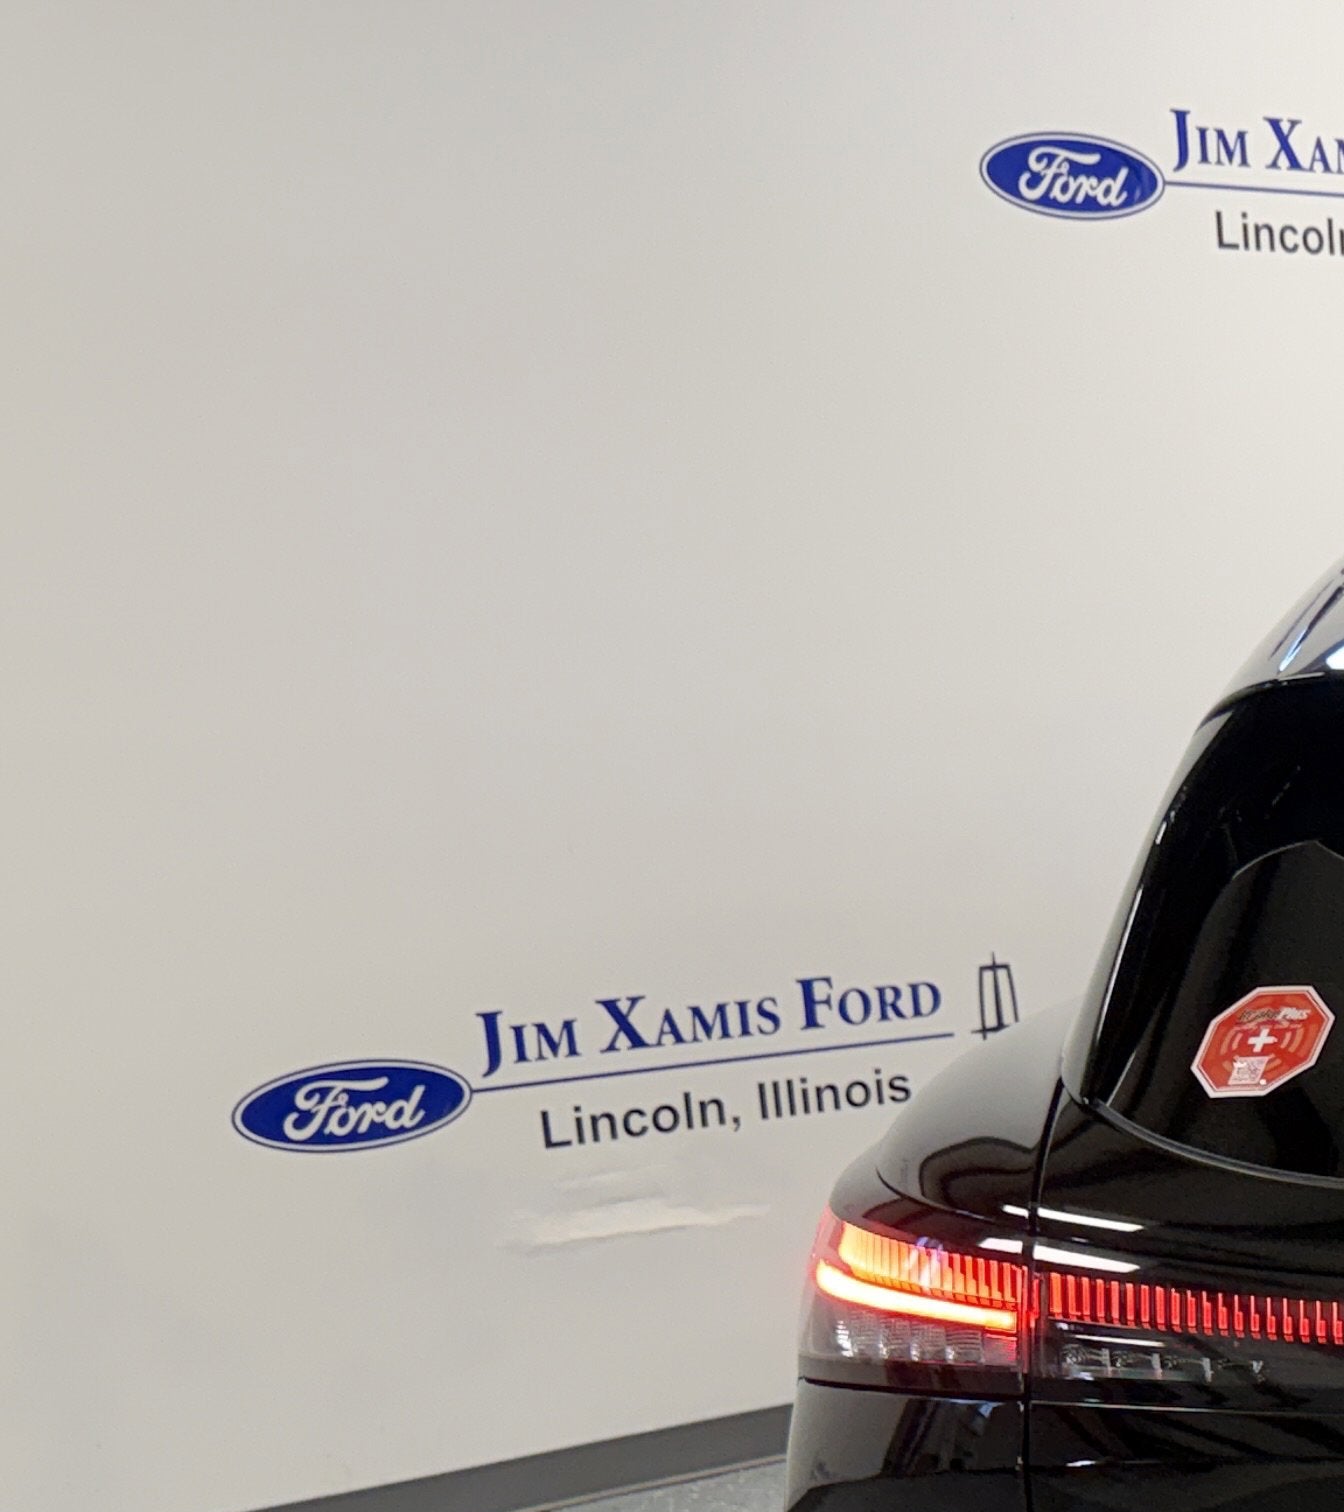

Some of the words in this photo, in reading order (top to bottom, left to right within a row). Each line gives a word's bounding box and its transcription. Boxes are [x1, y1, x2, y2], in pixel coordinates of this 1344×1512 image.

[1169, 108, 1251, 172] JIM
[1018, 145, 1129, 207] Ford
[476, 1010, 579, 1078] JIM
[596, 993, 782, 1054] XAMIS
[796, 976, 941, 1030] FORD
[282, 1077, 426, 1141] Ford
[540, 1090, 742, 1150] Lincoln,
[756, 1067, 912, 1121] Illinois
